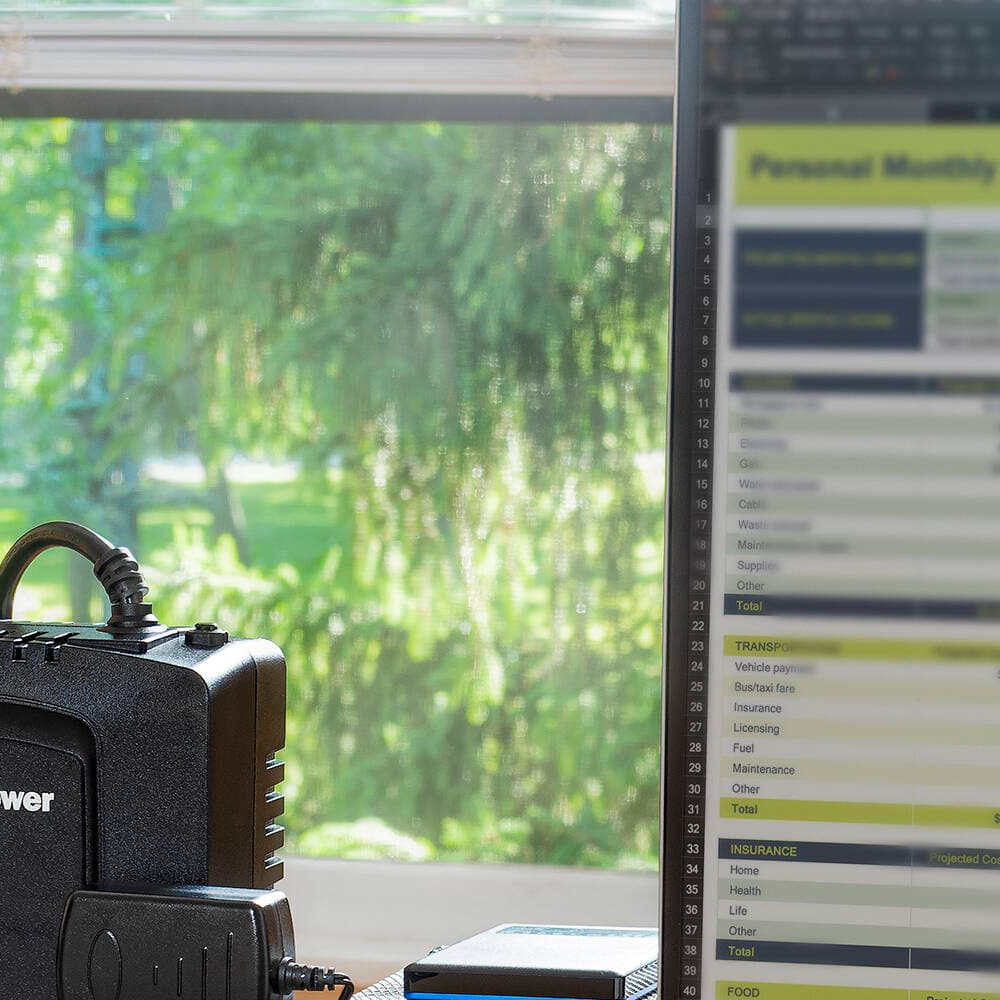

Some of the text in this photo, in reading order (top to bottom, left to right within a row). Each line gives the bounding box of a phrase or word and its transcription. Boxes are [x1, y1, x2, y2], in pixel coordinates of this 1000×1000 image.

[706, 194, 710, 202] 1
[705, 216, 711, 225] 2
[704, 236, 710, 246] 3
[704, 255, 710, 264] 4
[704, 275, 710, 284] 5
[703, 296, 710, 306] 6
[703, 315, 710, 325] 7
[702, 336, 708, 346] 8
[702, 358, 708, 368] 9
[699, 378, 710, 388] 10
[698, 398, 709, 408] 11
[698, 418, 709, 428] 12
[697, 438, 708, 448] 13
[696, 459, 708, 469] 14
[696, 480, 708, 490] 15
[696, 500, 708, 510] 16
[694, 580, 706, 590] 20
[736, 580, 764, 590] Other
[692, 601, 704, 611] 21
[736, 600, 762, 611] Total
[692, 621, 704, 631] 22
[692, 641, 704, 651] 23
[690, 662, 703, 672] 24
[734, 662, 770, 672] Vehicle
[690, 682, 703, 692] 25
[734, 682, 796, 694] Bus/taxi fare
[690, 702, 702, 712] 26
[734, 702, 782, 713] Insurance
[690, 722, 702, 732] 27
[733, 723, 780, 736] Licensing
[689, 742, 702, 752] 28
[732, 743, 754, 754] Fuel
[688, 763, 701, 773] 29
[732, 764, 795, 774] Maintenance
[688, 784, 700, 794] 30
[732, 784, 760, 794] Other
[688, 804, 700, 814] 31
[732, 804, 758, 814] Total
[687, 824, 700, 834] 32
[687, 844, 700, 854] 33
[730, 845, 798, 856] INSURANCE
[930, 852, 979, 866] Projected
[686, 864, 699, 874] 34
[730, 866, 760, 876] Home
[686, 884, 698, 894] 35
[730, 886, 762, 896] Health
[686, 905, 698, 914] 36
[729, 906, 748, 916] Life
[685, 925, 698, 935] 37
[728, 926, 757, 936] Other
[684, 946, 697, 956] 38
[728, 946, 754, 957] Total
[684, 966, 696, 976] 39
[683, 986, 696, 996] 40
[728, 987, 760, 998] FOOD
